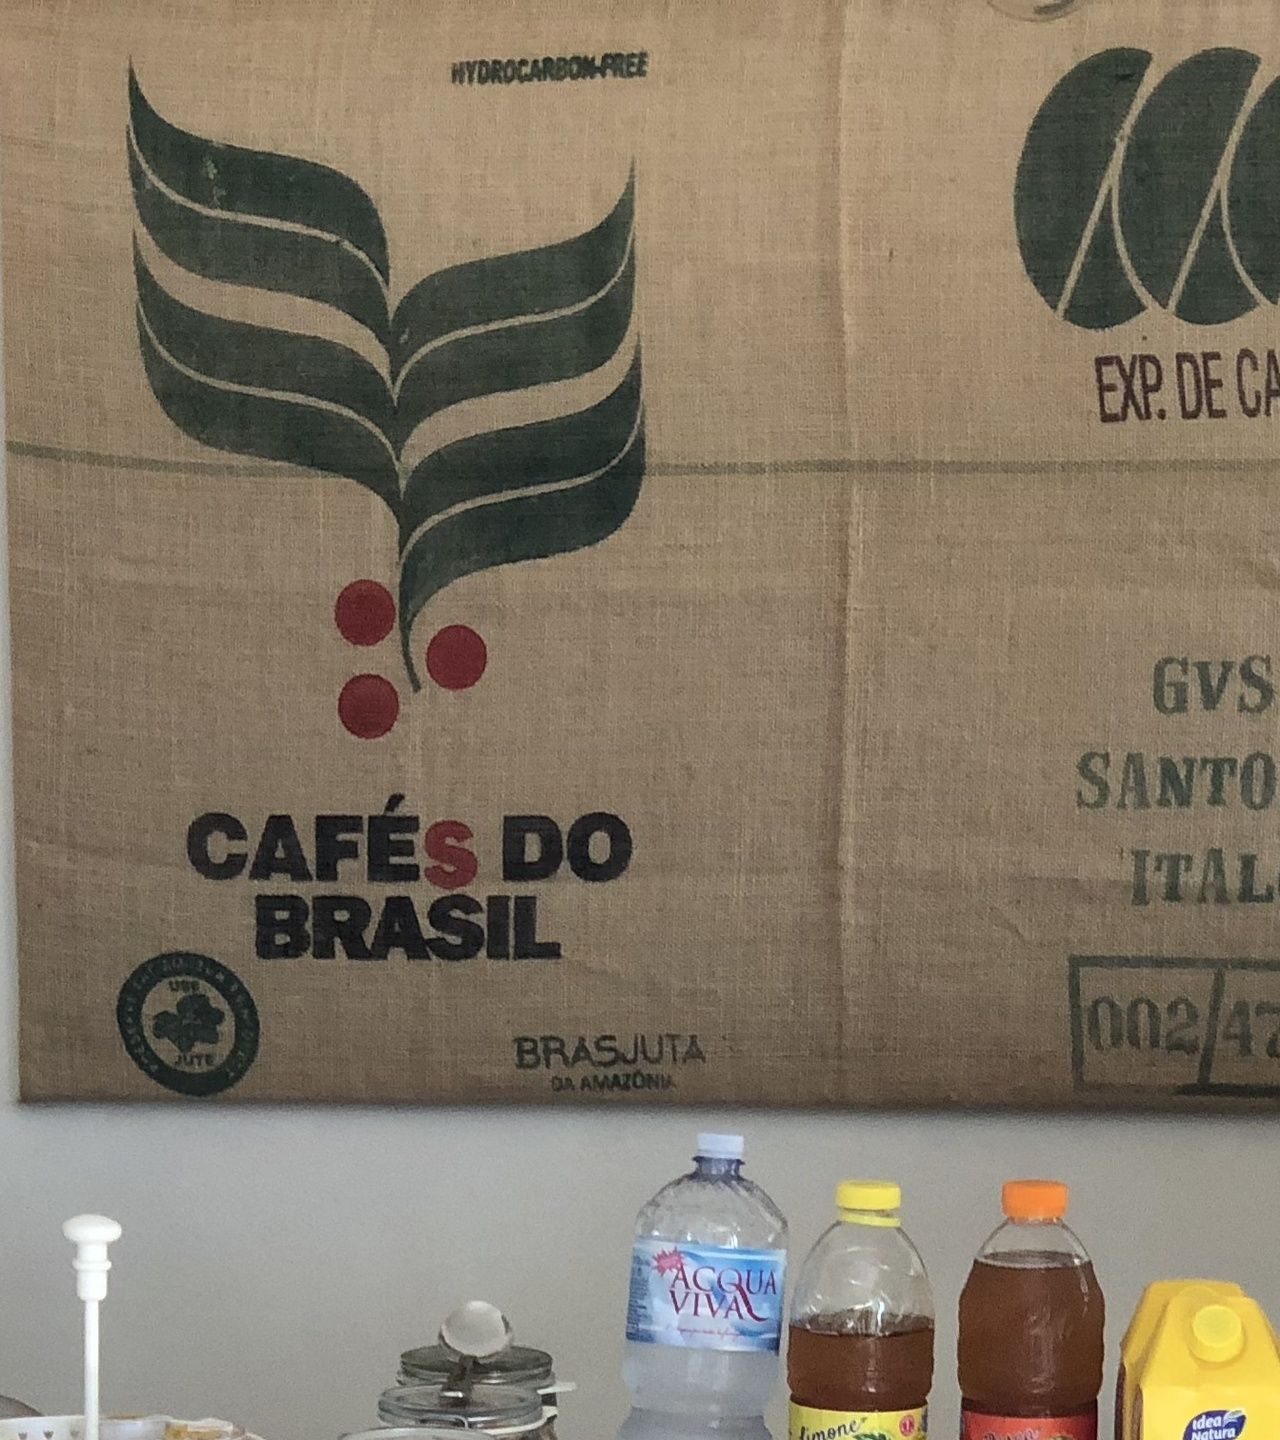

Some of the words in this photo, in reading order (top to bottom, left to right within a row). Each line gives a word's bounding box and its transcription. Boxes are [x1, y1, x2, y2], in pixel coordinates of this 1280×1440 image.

[451, 52, 649, 85] HYDROCARBON-FREE
[1094, 353, 1167, 423] EXP.
[1178, 351, 1227, 419] DE
[186, 793, 478, 889] CAFÉS
[502, 811, 633, 882] DO
[255, 894, 562, 961] BRASIL
[513, 1033, 706, 1069] BRASJUTA
[551, 1075, 575, 1091] DA
[670, 1290, 745, 1320] VIVA
[671, 1261, 776, 1322] ACQUA
